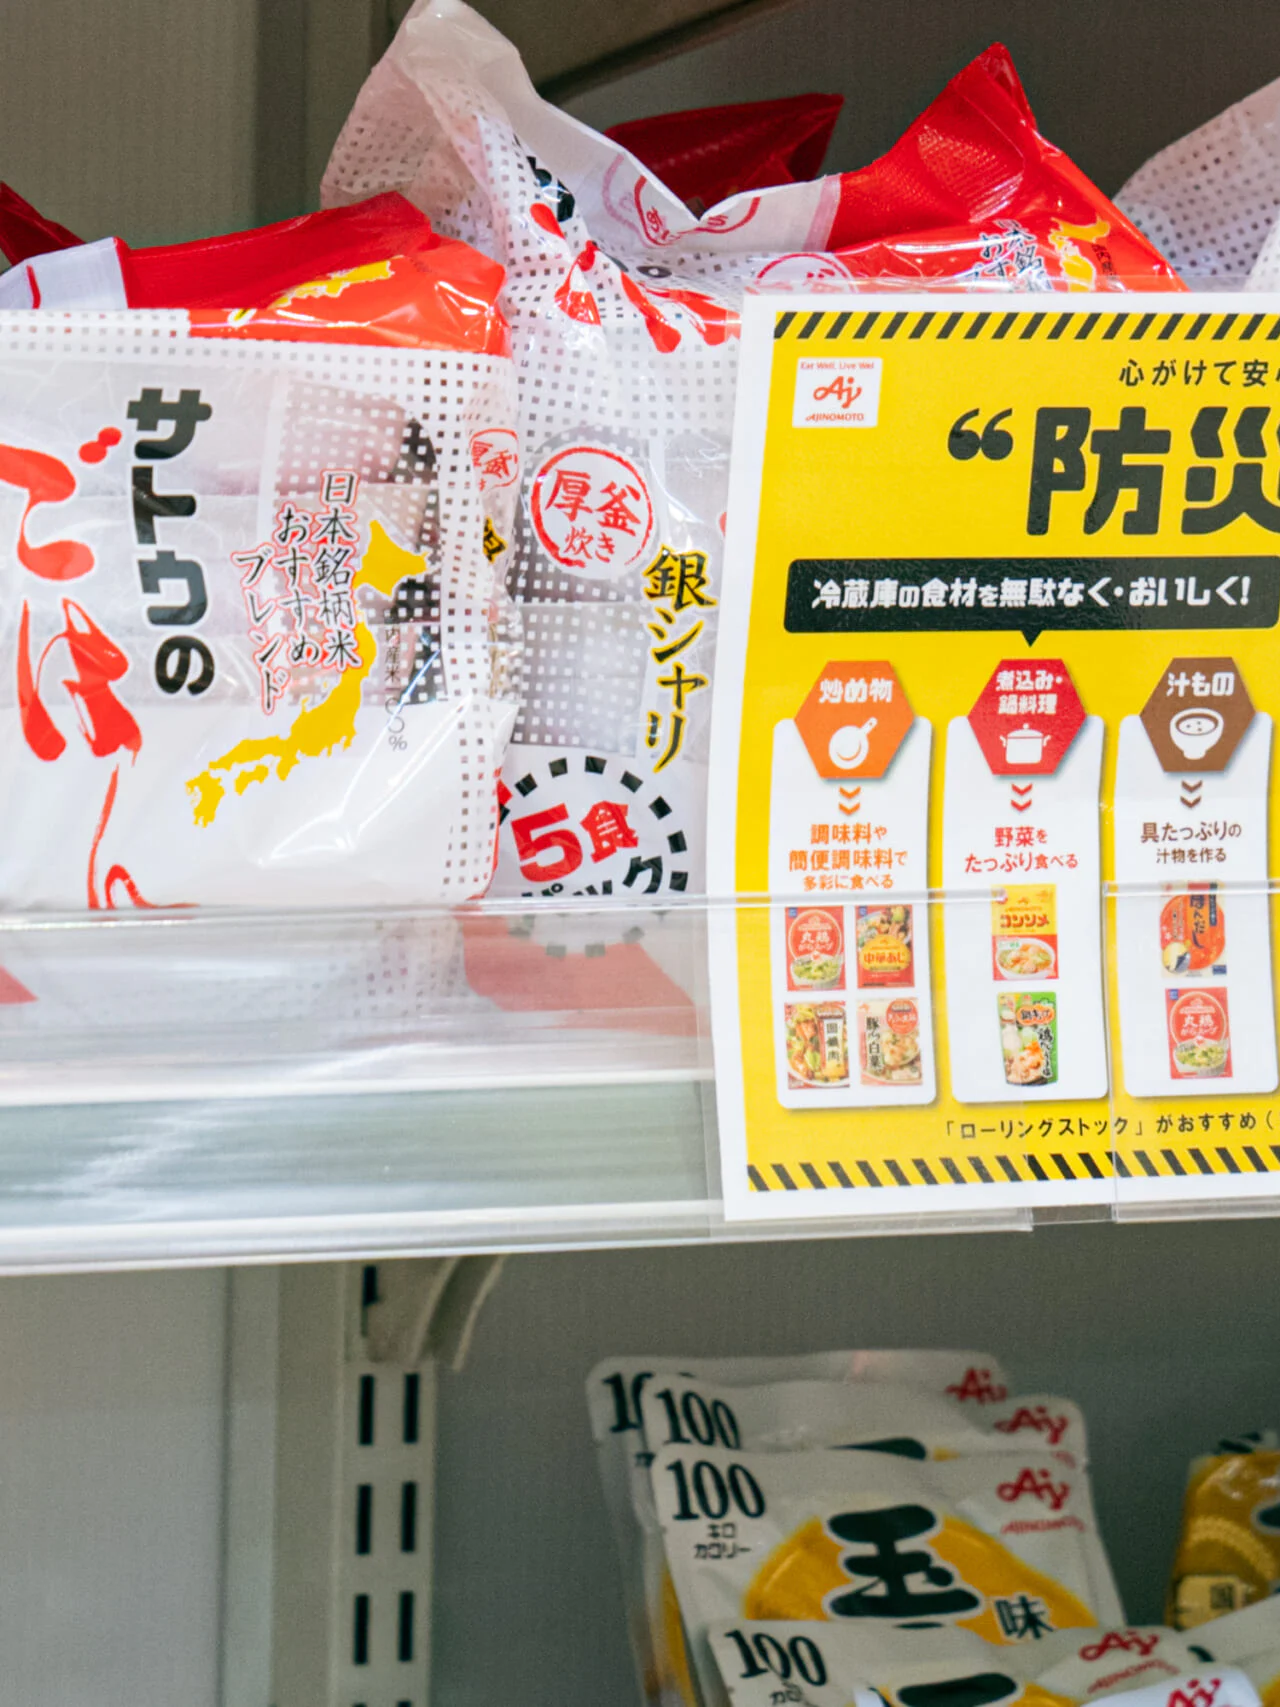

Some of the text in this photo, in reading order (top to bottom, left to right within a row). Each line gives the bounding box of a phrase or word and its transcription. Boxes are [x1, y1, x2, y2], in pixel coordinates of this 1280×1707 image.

[805, 412, 865, 422] AJINOMOTO
[550, 470, 643, 536] 厚釜
[126, 387, 216, 696] サトウの
[317, 471, 362, 668] 日本銘柄米
[277, 504, 322, 664] おすすめ
[811, 575, 1251, 610] 冷蔵庫の食材を無駄なく・おいしく!
[232, 545, 294, 714] ブレンド
[643, 542, 717, 773] 銀シャリ
[819, 678, 893, 704] 炒め物
[1166, 671, 1236, 698] 汁もの
[998, 693, 1057, 715] 鍋料理
[510, 800, 640, 883] 5食
[810, 823, 888, 846] 調味料や
[994, 825, 1048, 848] 野菜を
[1140, 821, 1243, 845] 具たっぷりの
[788, 847, 909, 872] 簡便調味料で
[964, 851, 1079, 874] たっぷり食べる
[1155, 846, 1228, 865] 汁物を作る
[803, 874, 894, 892] 多彩に食べる
[656, 1390, 740, 1450] 100
[667, 1460, 767, 1522] 100
[707, 1524, 738, 1540] キロ
[692, 1542, 753, 1560] カロリー
[995, 1595, 1055, 1641] 味
[724, 1629, 829, 1687] 100
